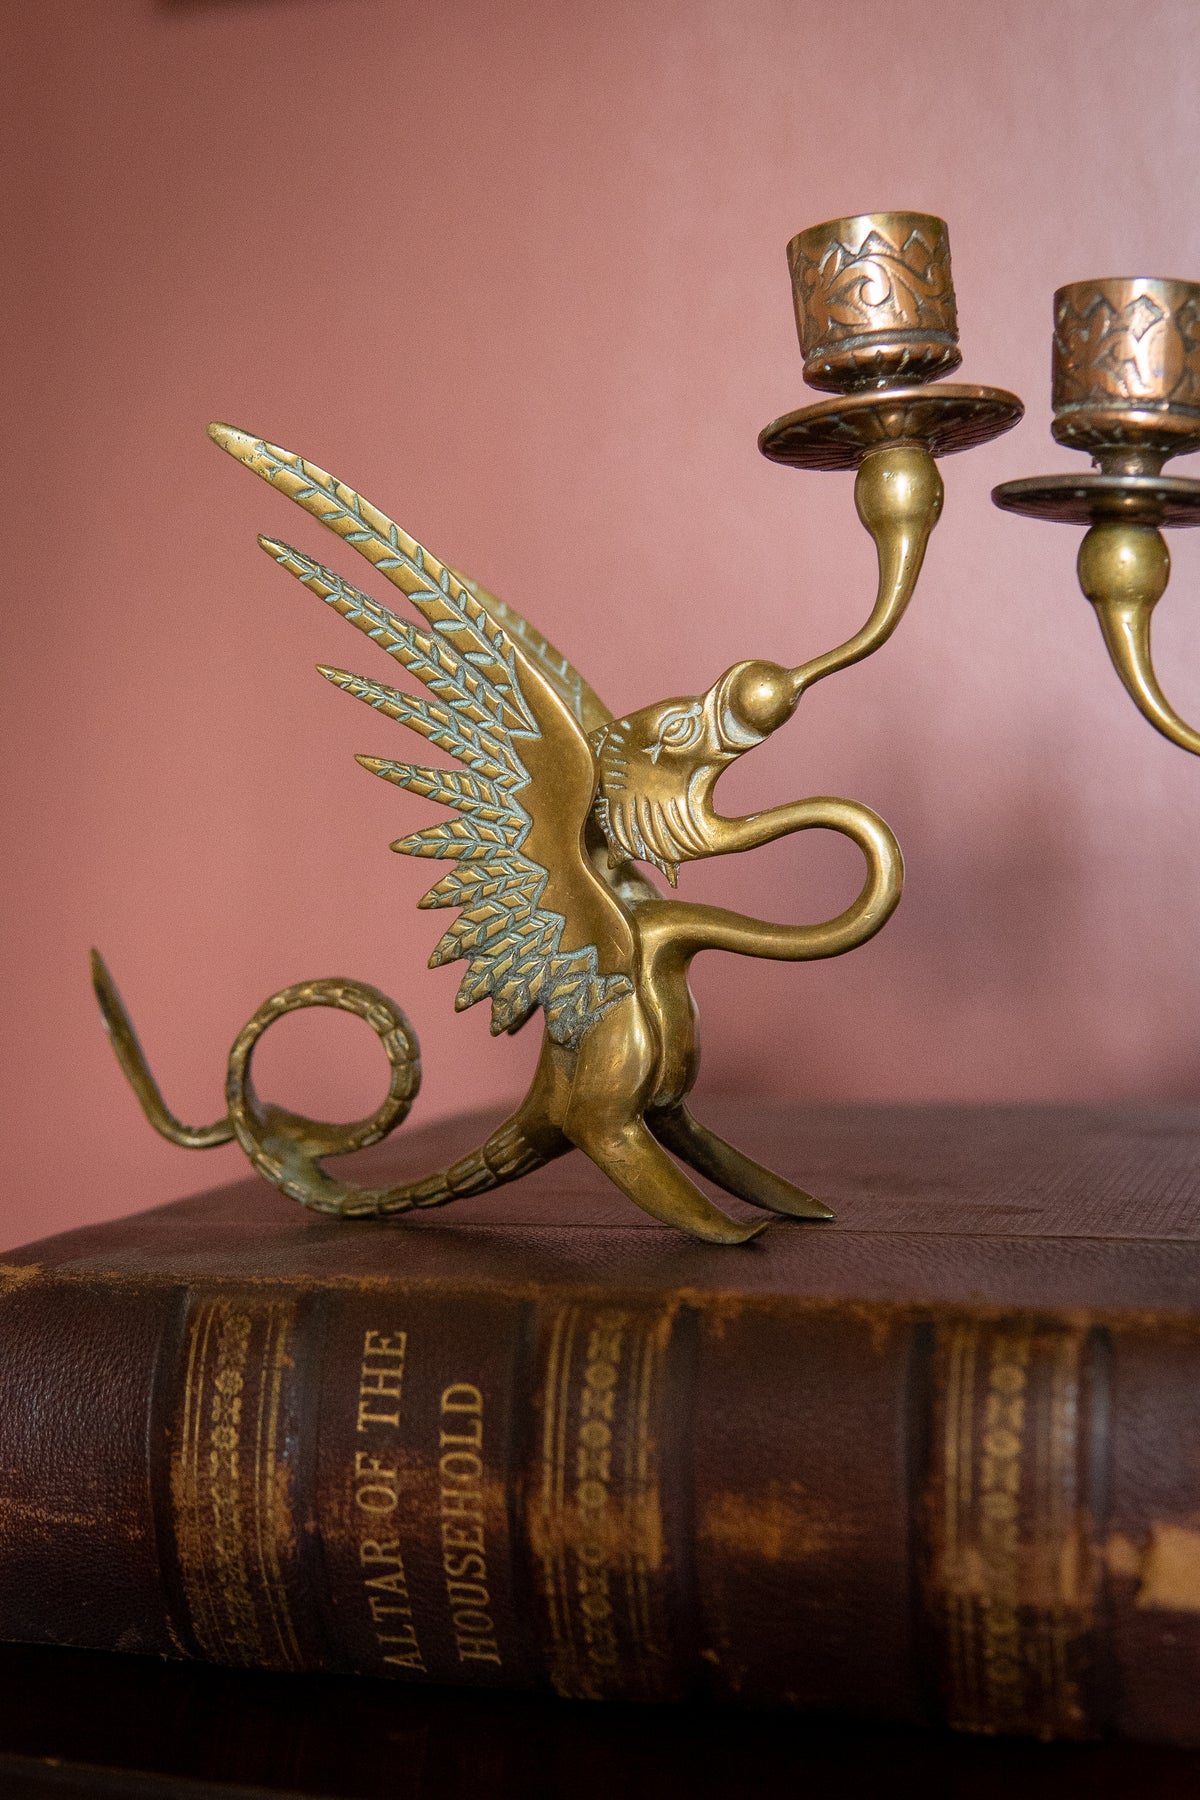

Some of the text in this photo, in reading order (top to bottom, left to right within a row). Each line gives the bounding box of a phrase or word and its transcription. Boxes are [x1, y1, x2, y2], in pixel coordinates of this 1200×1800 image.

[355, 1330, 427, 1672] ALTAR OF THE
[441, 1383, 501, 1664] HOUSEHOLD
